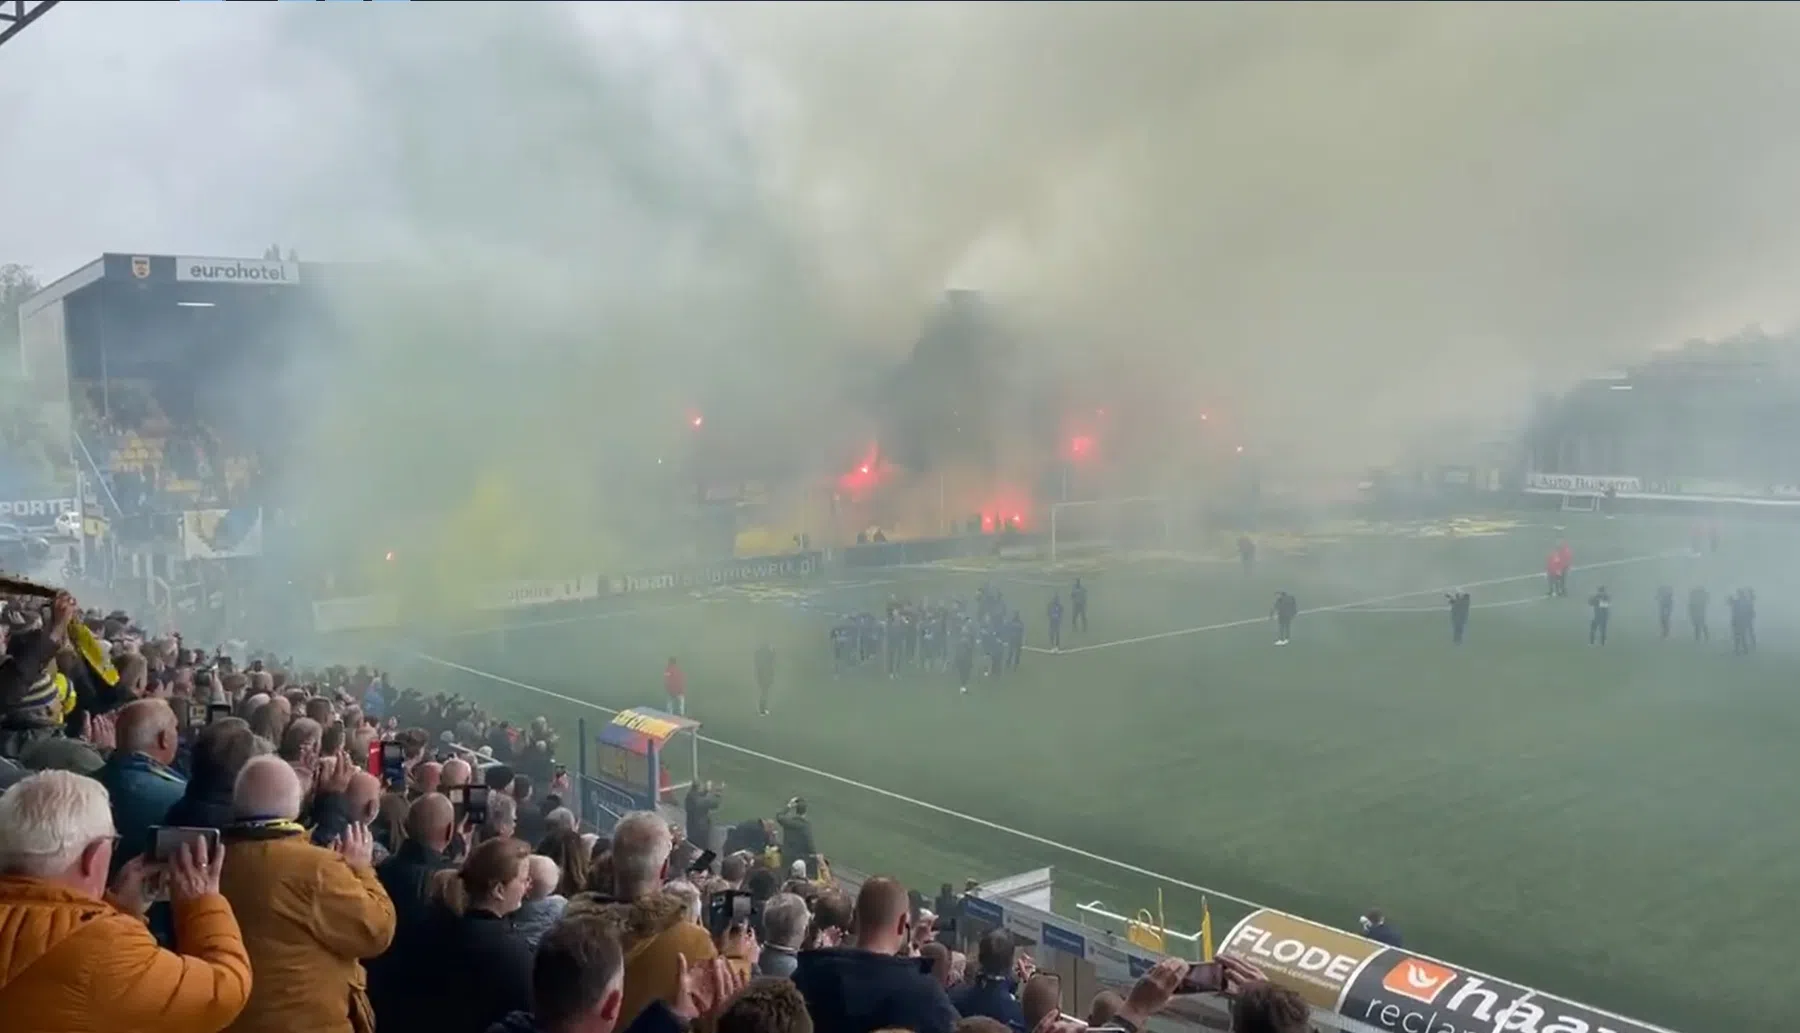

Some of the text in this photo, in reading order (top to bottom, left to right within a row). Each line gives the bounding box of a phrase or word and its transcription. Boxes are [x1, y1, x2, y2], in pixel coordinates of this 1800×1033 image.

[190, 262, 287, 281] eurohotel
[0, 497, 79, 516] PORTE
[1230, 925, 1359, 981] FLODE
